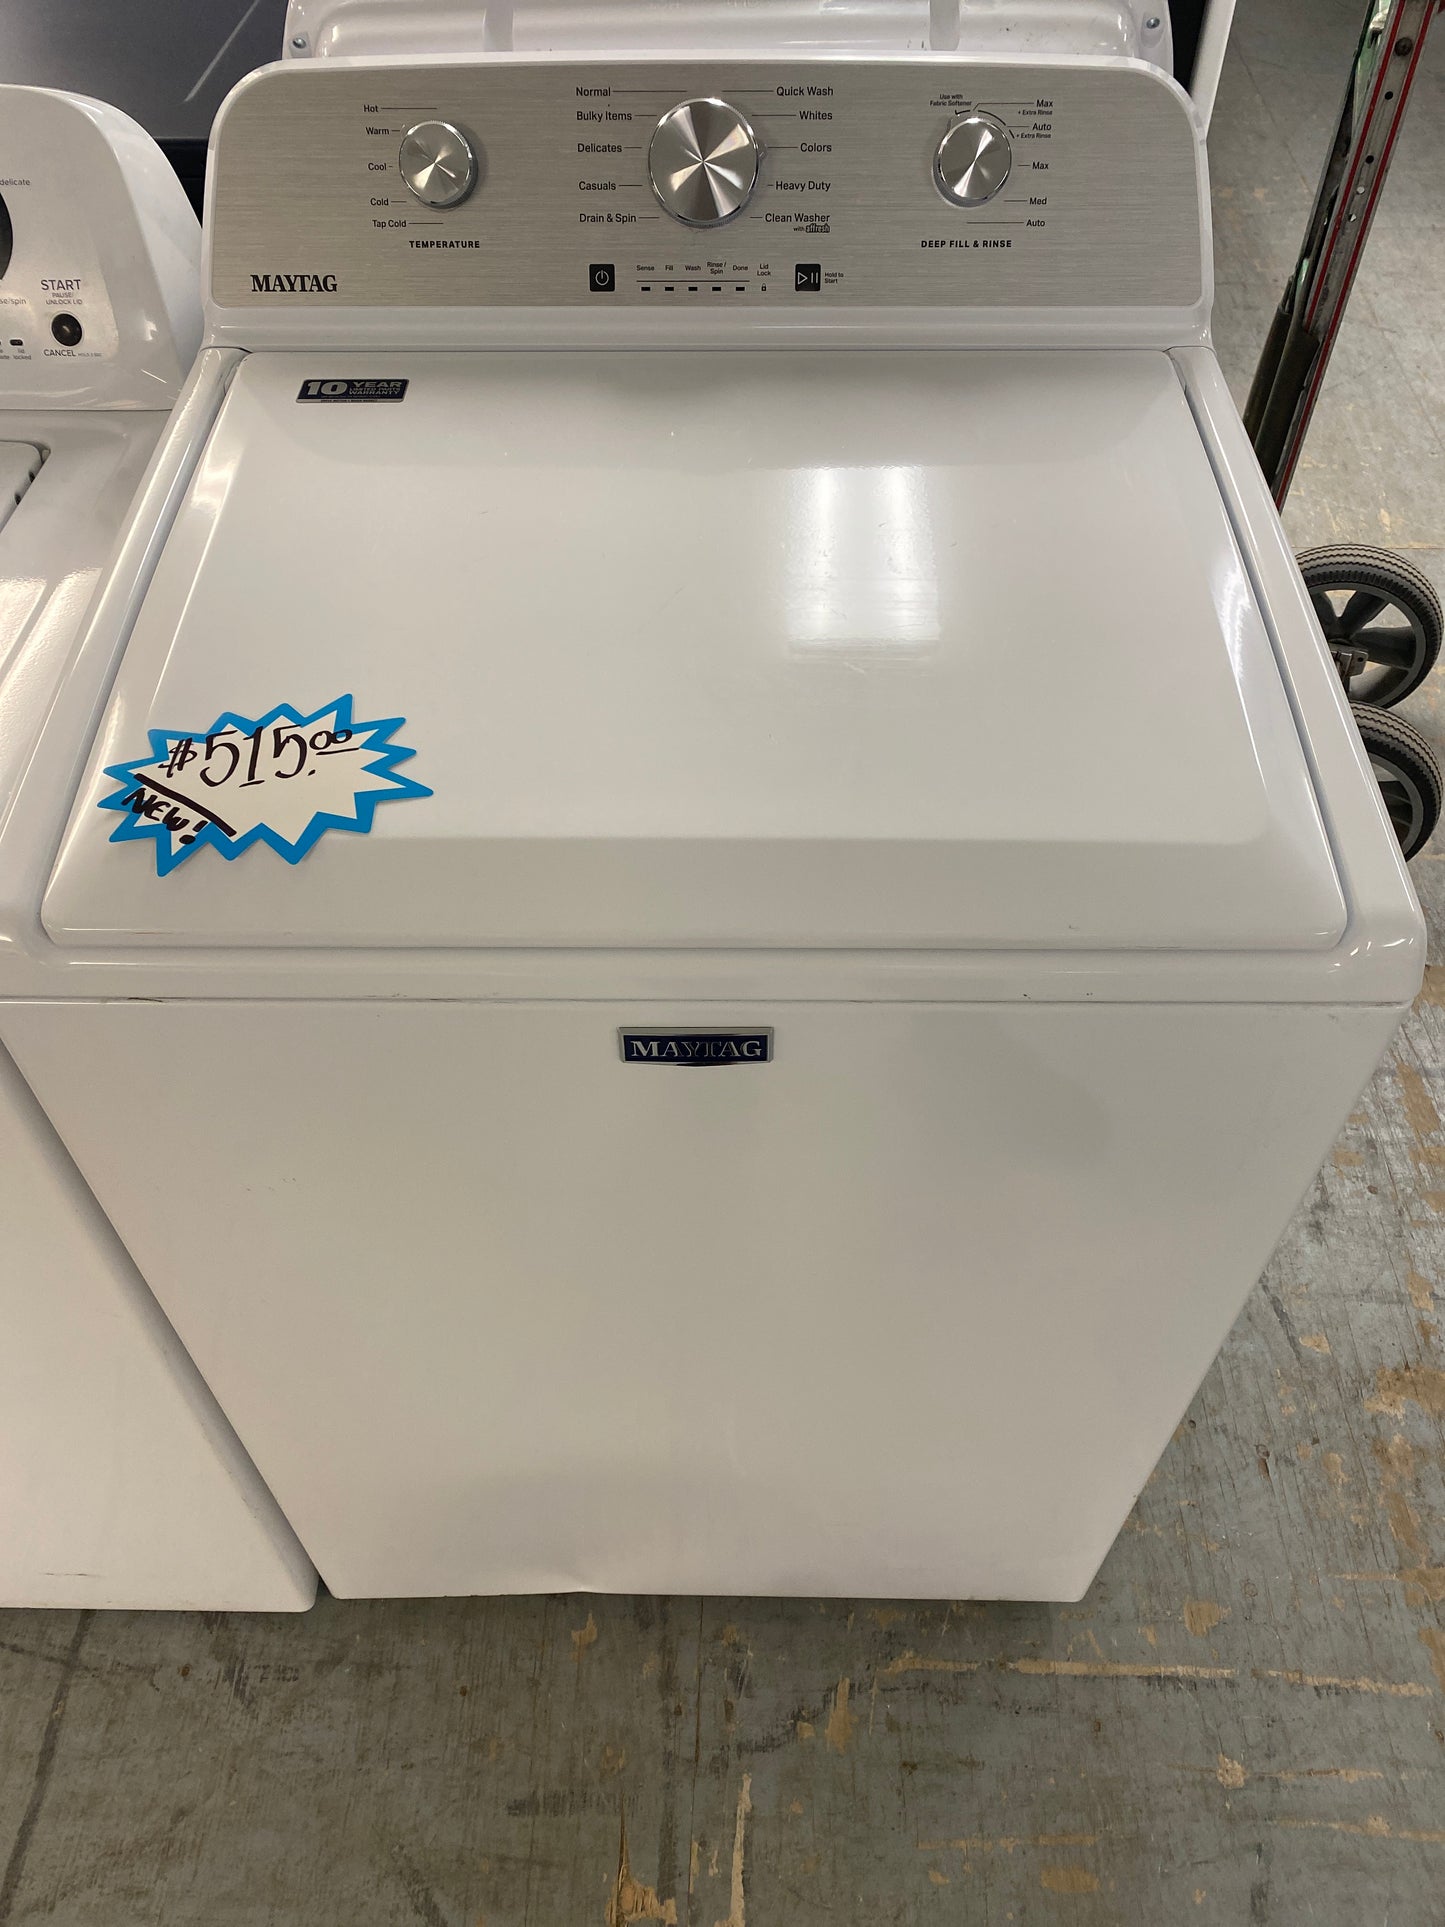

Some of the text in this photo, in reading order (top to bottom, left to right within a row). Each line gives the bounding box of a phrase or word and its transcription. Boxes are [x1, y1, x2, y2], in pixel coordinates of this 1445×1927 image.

[576, 87, 611, 97] Normal
[776, 86, 834, 97] Quick Wash
[1036, 99, 1053, 107] Max
[363, 104, 379, 113] Hot
[576, 111, 632, 123] Bulky Items
[799, 110, 833, 120] Whites
[365, 127, 390, 136] Warm
[1032, 122, 1052, 131] Auto
[577, 143, 622, 153] Delicates
[800, 142, 832, 152] Colors
[368, 162, 387, 171] Cool
[1032, 161, 1049, 170] Max
[578, 181, 616, 191] Casuals
[775, 180, 831, 193] Heavy Duty
[370, 198, 389, 206] Cold
[1029, 197, 1047, 205] Med
[579, 213, 637, 225] Drain & Spin
[765, 212, 830, 222] Clean Washer
[372, 219, 407, 228] Tap Cold
[1026, 219, 1046, 227] Auto
[409, 240, 480, 249] TEMPERATURE
[921, 240, 1012, 248] DEEP FILL & RINSE
[41, 279, 81, 291] START
[250, 274, 338, 292] MAYTAG
[43, 349, 76, 357] CANCEL
[307, 381, 348, 395] 10
[121, 787, 208, 845] NEW!
[630, 1040, 763, 1058] MAYTAG
